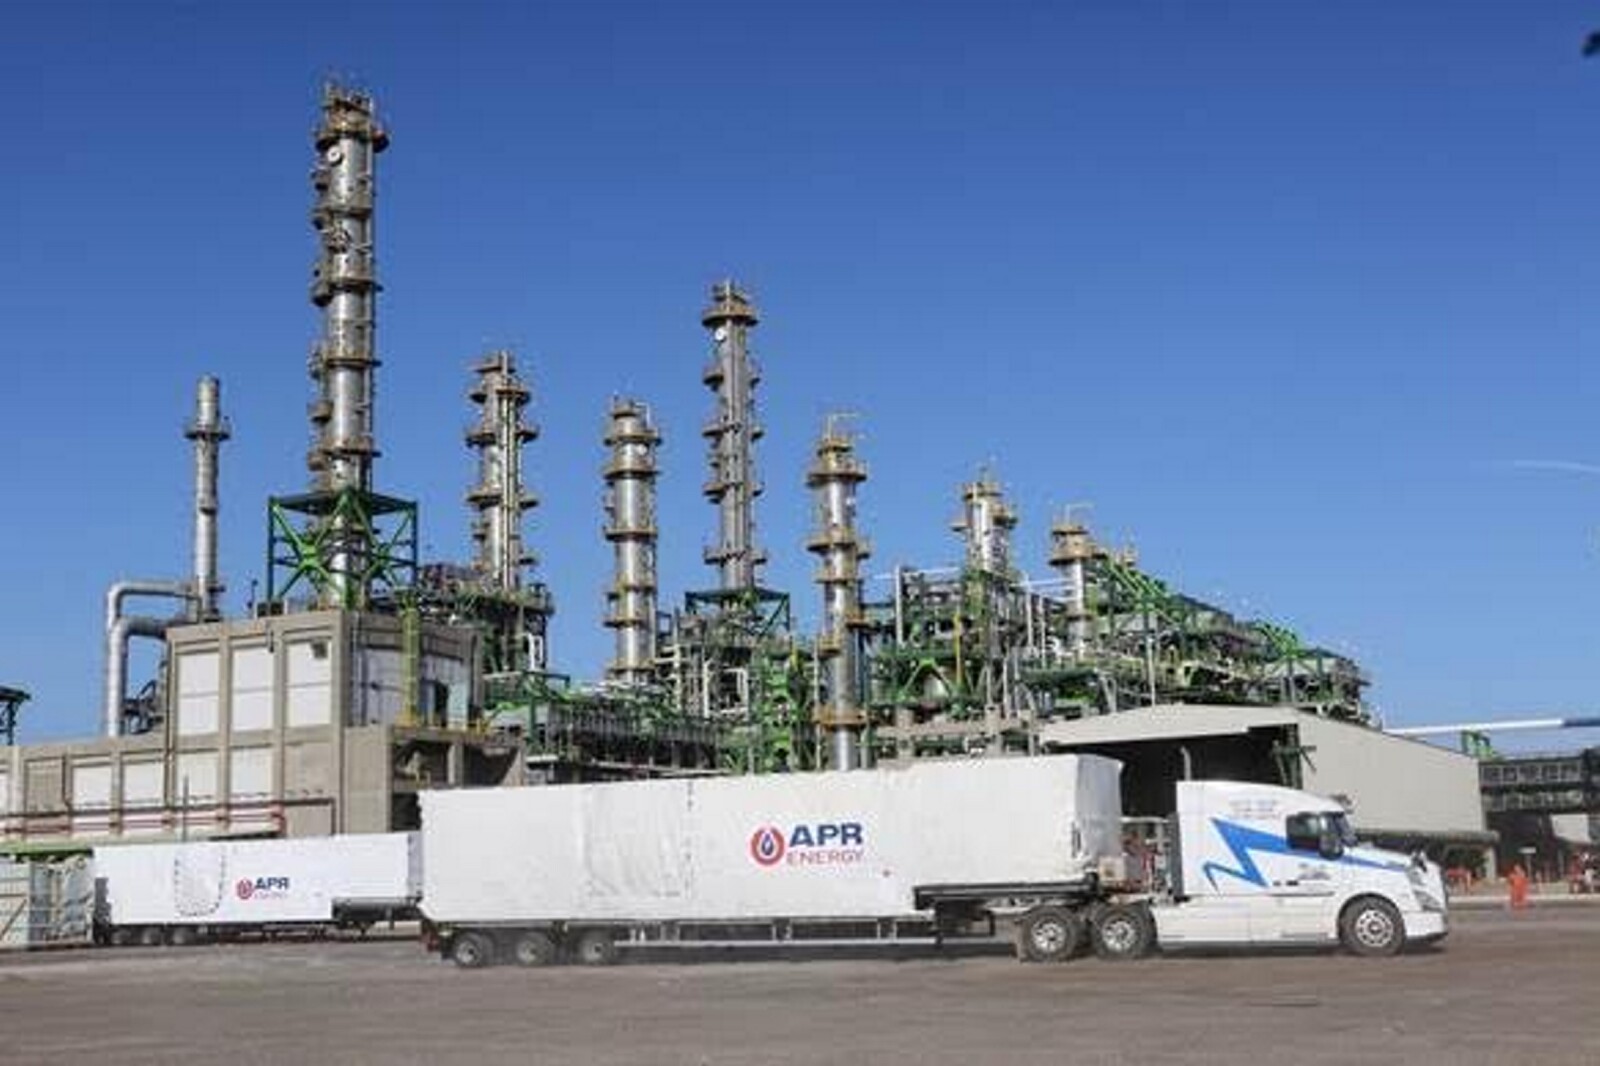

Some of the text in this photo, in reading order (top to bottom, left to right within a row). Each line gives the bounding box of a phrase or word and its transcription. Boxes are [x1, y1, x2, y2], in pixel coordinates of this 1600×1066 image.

[789, 822, 863, 847] APR
[786, 850, 864, 866] ENERGY
[255, 877, 290, 890] APR
